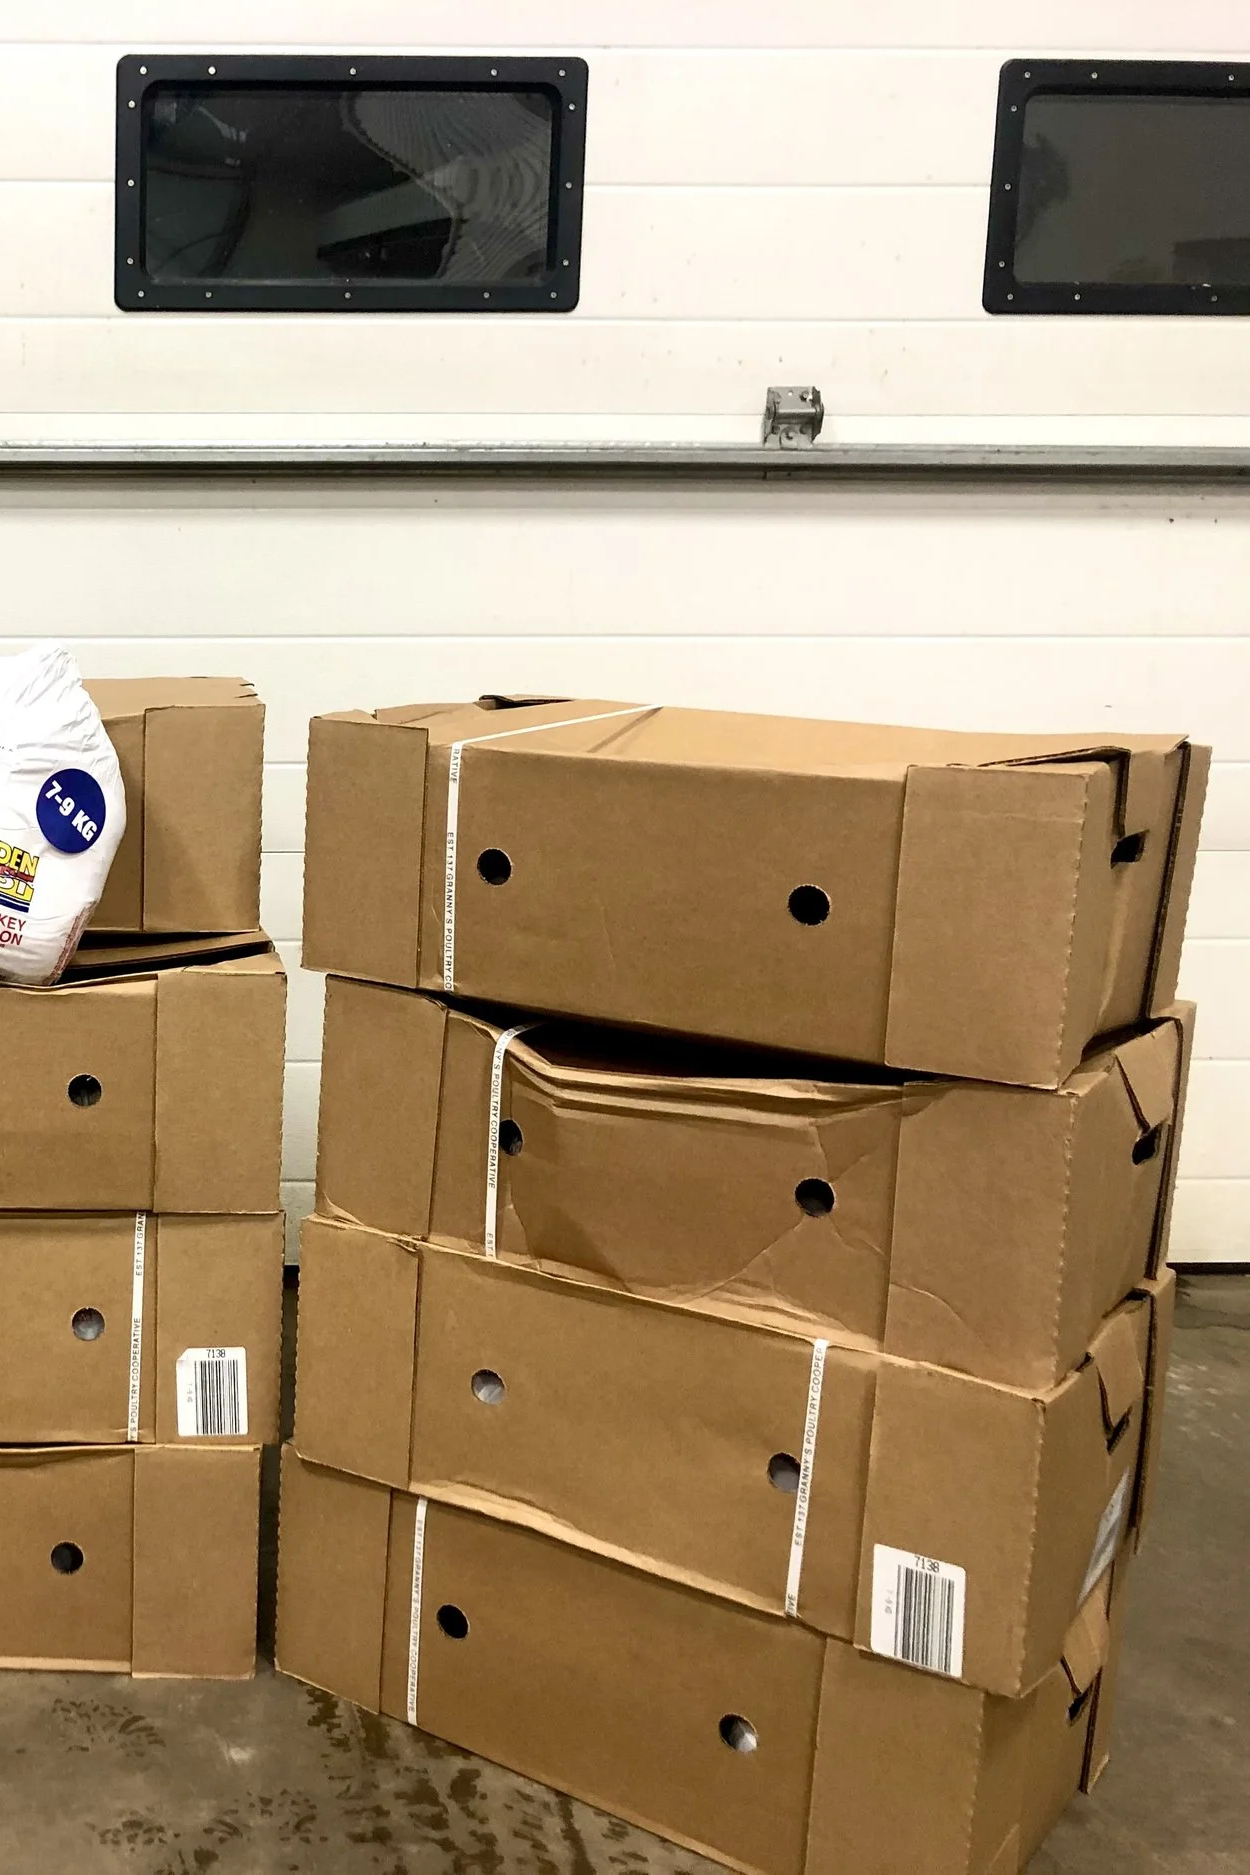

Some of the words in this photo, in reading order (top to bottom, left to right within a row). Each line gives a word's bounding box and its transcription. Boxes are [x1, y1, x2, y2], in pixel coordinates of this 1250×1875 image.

[45, 780, 75, 816] 7-9
[71, 809, 98, 842] KG
[445, 872, 453, 924] GRANNY'S
[444, 928, 453, 972] POULTRY
[490, 1072, 500, 1118] POULTRY
[487, 1118, 498, 1188] COOPERATIVE
[134, 1258, 143, 1276] EST
[130, 1317, 141, 1380] COOPERATIVE
[206, 1349, 226, 1359] 7138
[129, 1383, 138, 1424] POULTRY
[805, 1395, 818, 1444] POULTRY
[798, 1448, 813, 1502] GRANNY'S
[915, 1556, 940, 1573] 7138
